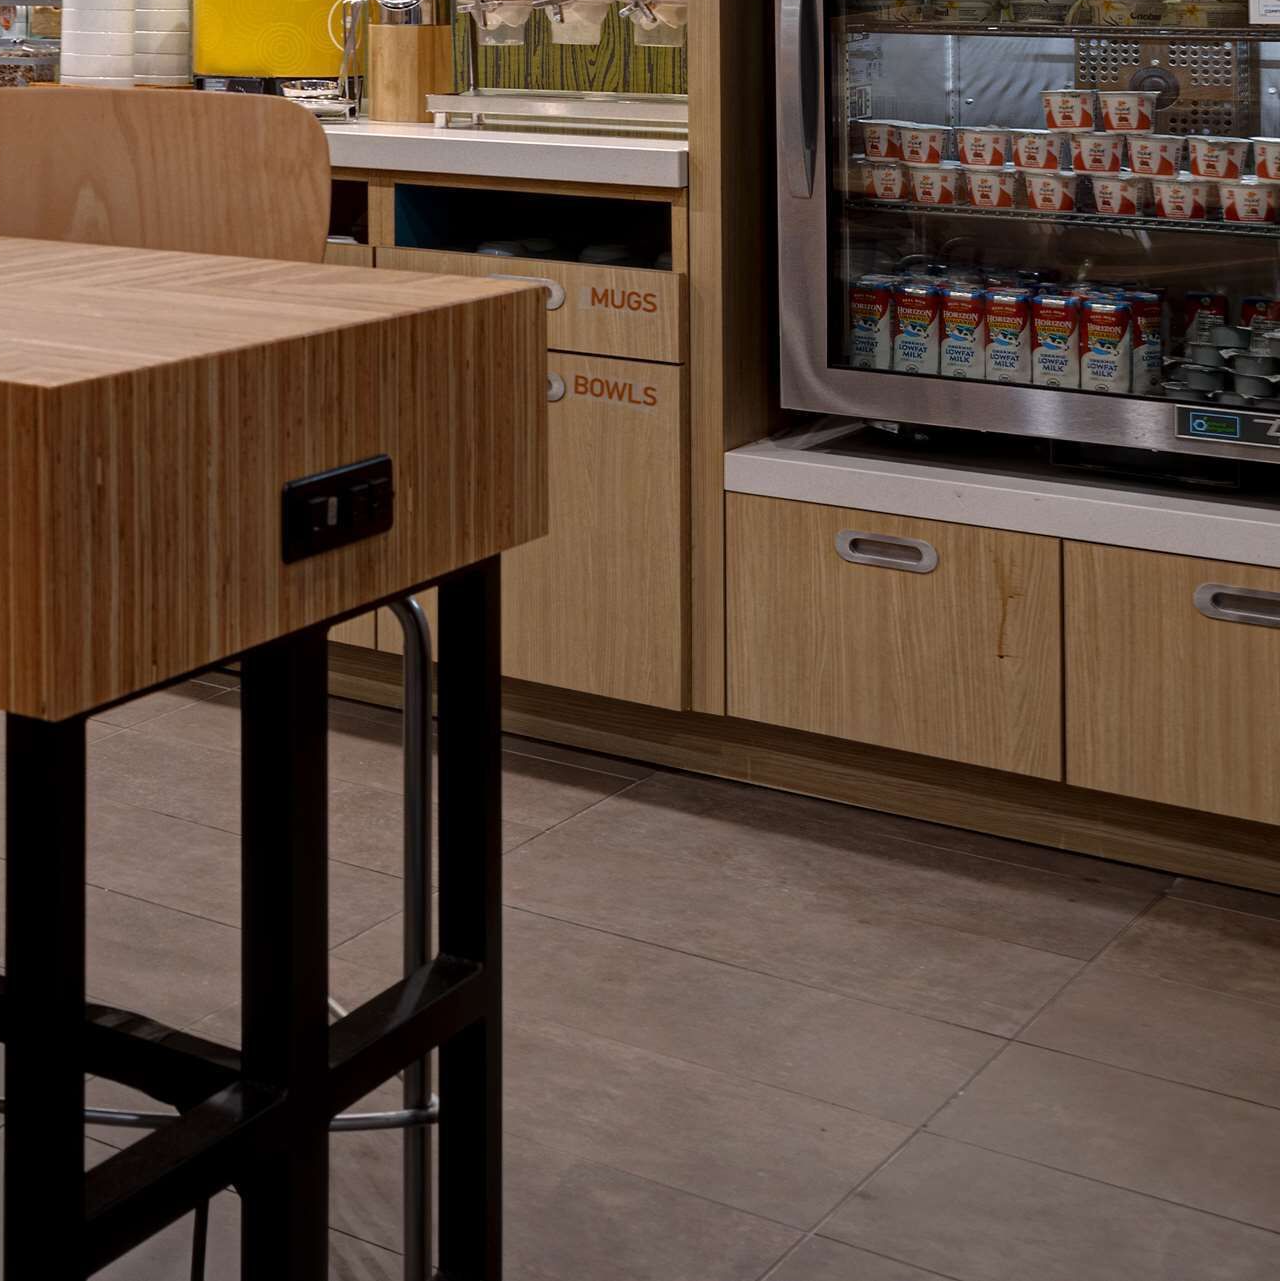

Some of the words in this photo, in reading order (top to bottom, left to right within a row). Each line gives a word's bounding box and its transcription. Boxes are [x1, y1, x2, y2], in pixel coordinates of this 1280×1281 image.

[591, 287, 657, 313] MUGS
[897, 306, 933, 317] HORIZON
[944, 310, 978, 321] HORIZON
[986, 314, 1023, 325] HORIZON
[1034, 318, 1072, 329] HORIZON
[1087, 323, 1122, 334] HORIZON
[899, 344, 928, 353] LOWFAT
[945, 348, 975, 358] LOWFAT
[902, 351, 922, 359] MILK
[949, 355, 970, 363] MILK
[990, 353, 1020, 362] LOWFAT
[994, 360, 1016, 369] MILK
[1038, 356, 1068, 366] LOWFAT
[1042, 364, 1064, 372] MILK
[1088, 362, 1118, 371] LOWFAT
[1092, 369, 1113, 378] MILK
[574, 375, 657, 406] BOWLS
